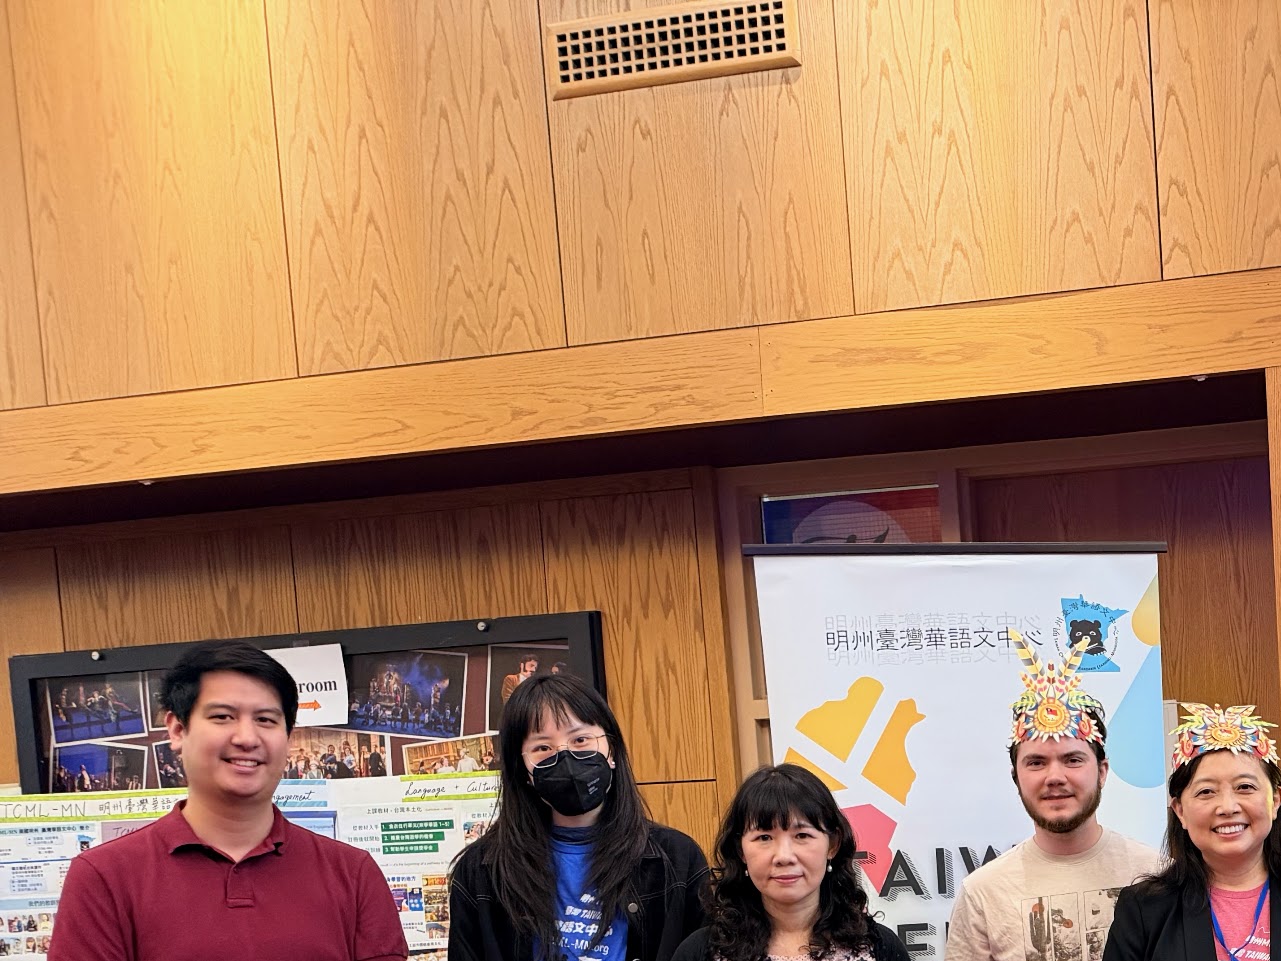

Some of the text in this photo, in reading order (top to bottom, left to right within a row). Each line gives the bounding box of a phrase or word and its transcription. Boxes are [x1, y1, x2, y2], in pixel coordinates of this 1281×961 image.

[296, 680, 338, 694] room
[405, 781, 446, 800] Language
[0, 798, 180, 819] TCML-MN 明州臺灣華語
